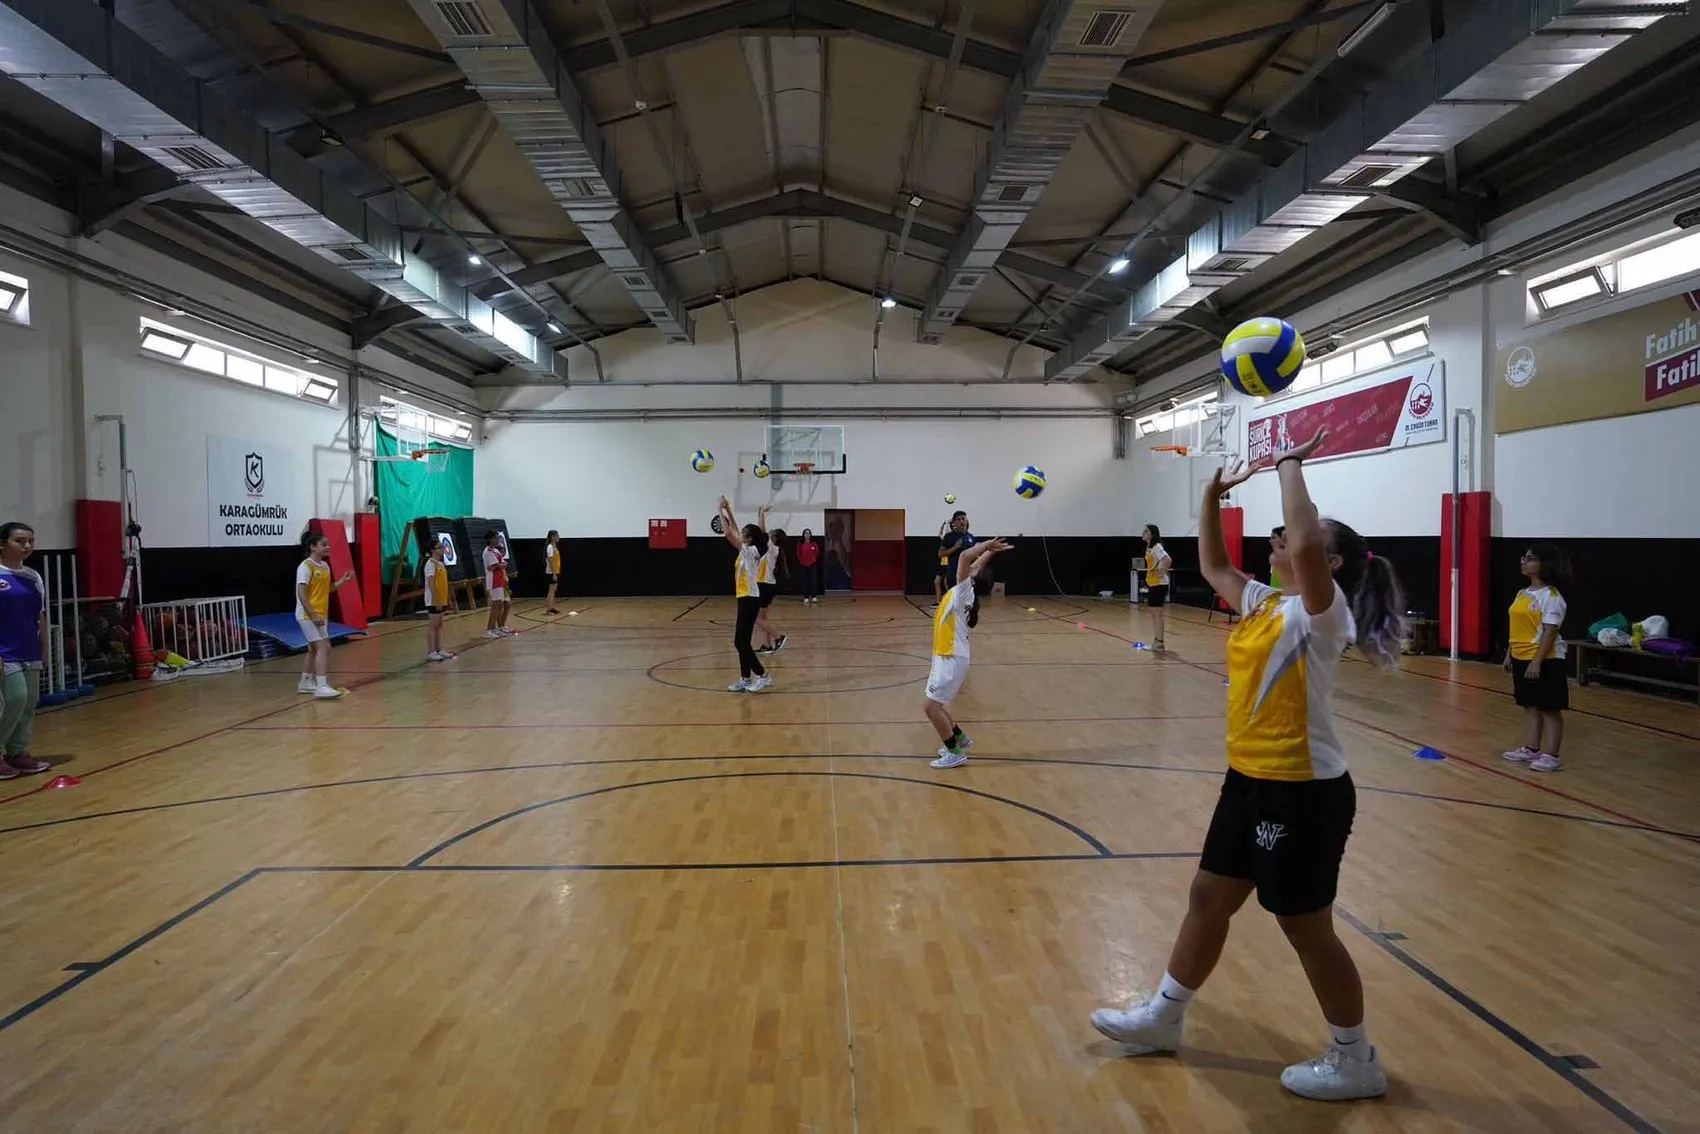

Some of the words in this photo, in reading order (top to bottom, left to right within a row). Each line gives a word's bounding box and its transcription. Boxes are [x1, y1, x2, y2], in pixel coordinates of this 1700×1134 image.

[1645, 318, 1697, 360] Fatih
[219, 503, 288, 519] KARAGÜMRÜK
[225, 523, 284, 536] ORTAOKULU
